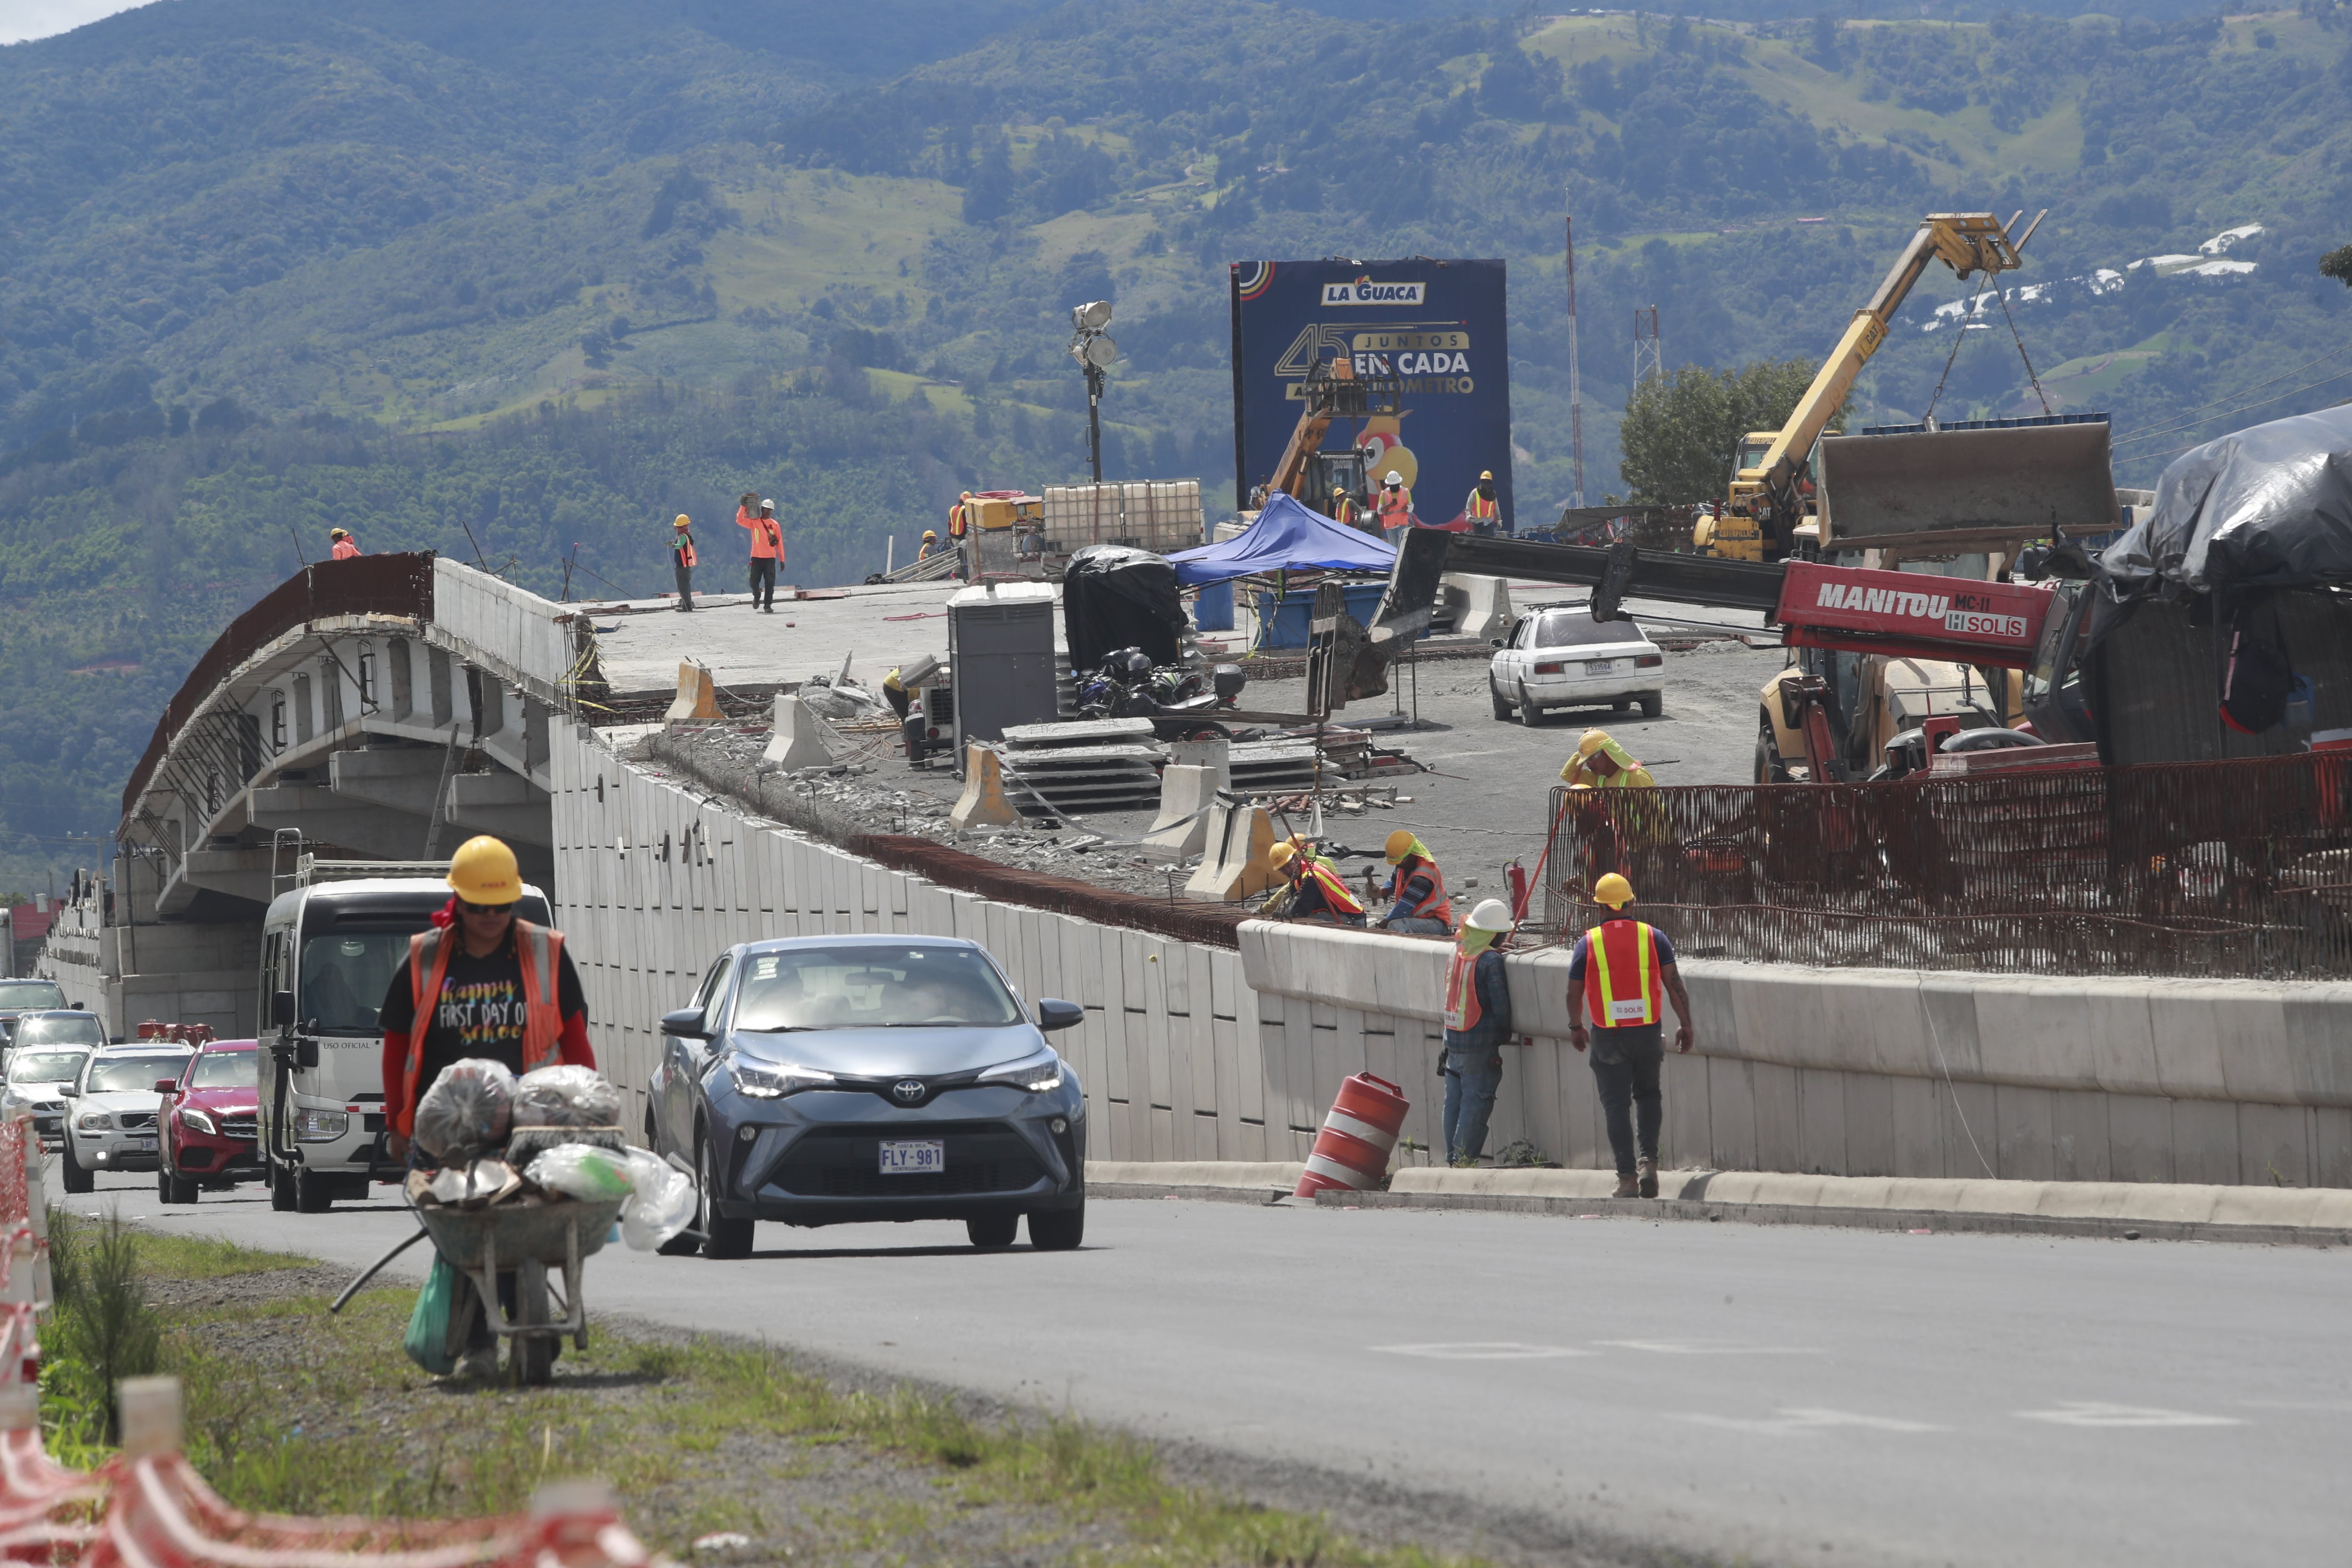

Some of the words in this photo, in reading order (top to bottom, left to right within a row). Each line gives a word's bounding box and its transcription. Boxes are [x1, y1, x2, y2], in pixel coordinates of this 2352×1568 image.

[1327, 287, 1350, 301] LA
[1356, 283, 1417, 301] GUACA
[1366, 335, 1458, 348] JUNTOS
[1866, 324, 1879, 344] CAT
[1355, 353, 1389, 374] EN
[1398, 352, 1470, 374] CADA
[1360, 376, 1474, 394] ILOMETRO
[1817, 583, 1949, 619] MANITOU
[1967, 617, 2022, 636] SOLÍS
[441, 977, 517, 1006] happy
[440, 1003, 475, 1027] FIRST
[481, 1003, 509, 1027] DAY
[460, 1016, 522, 1046] schoo
[882, 1149, 940, 1166] FLY-981
